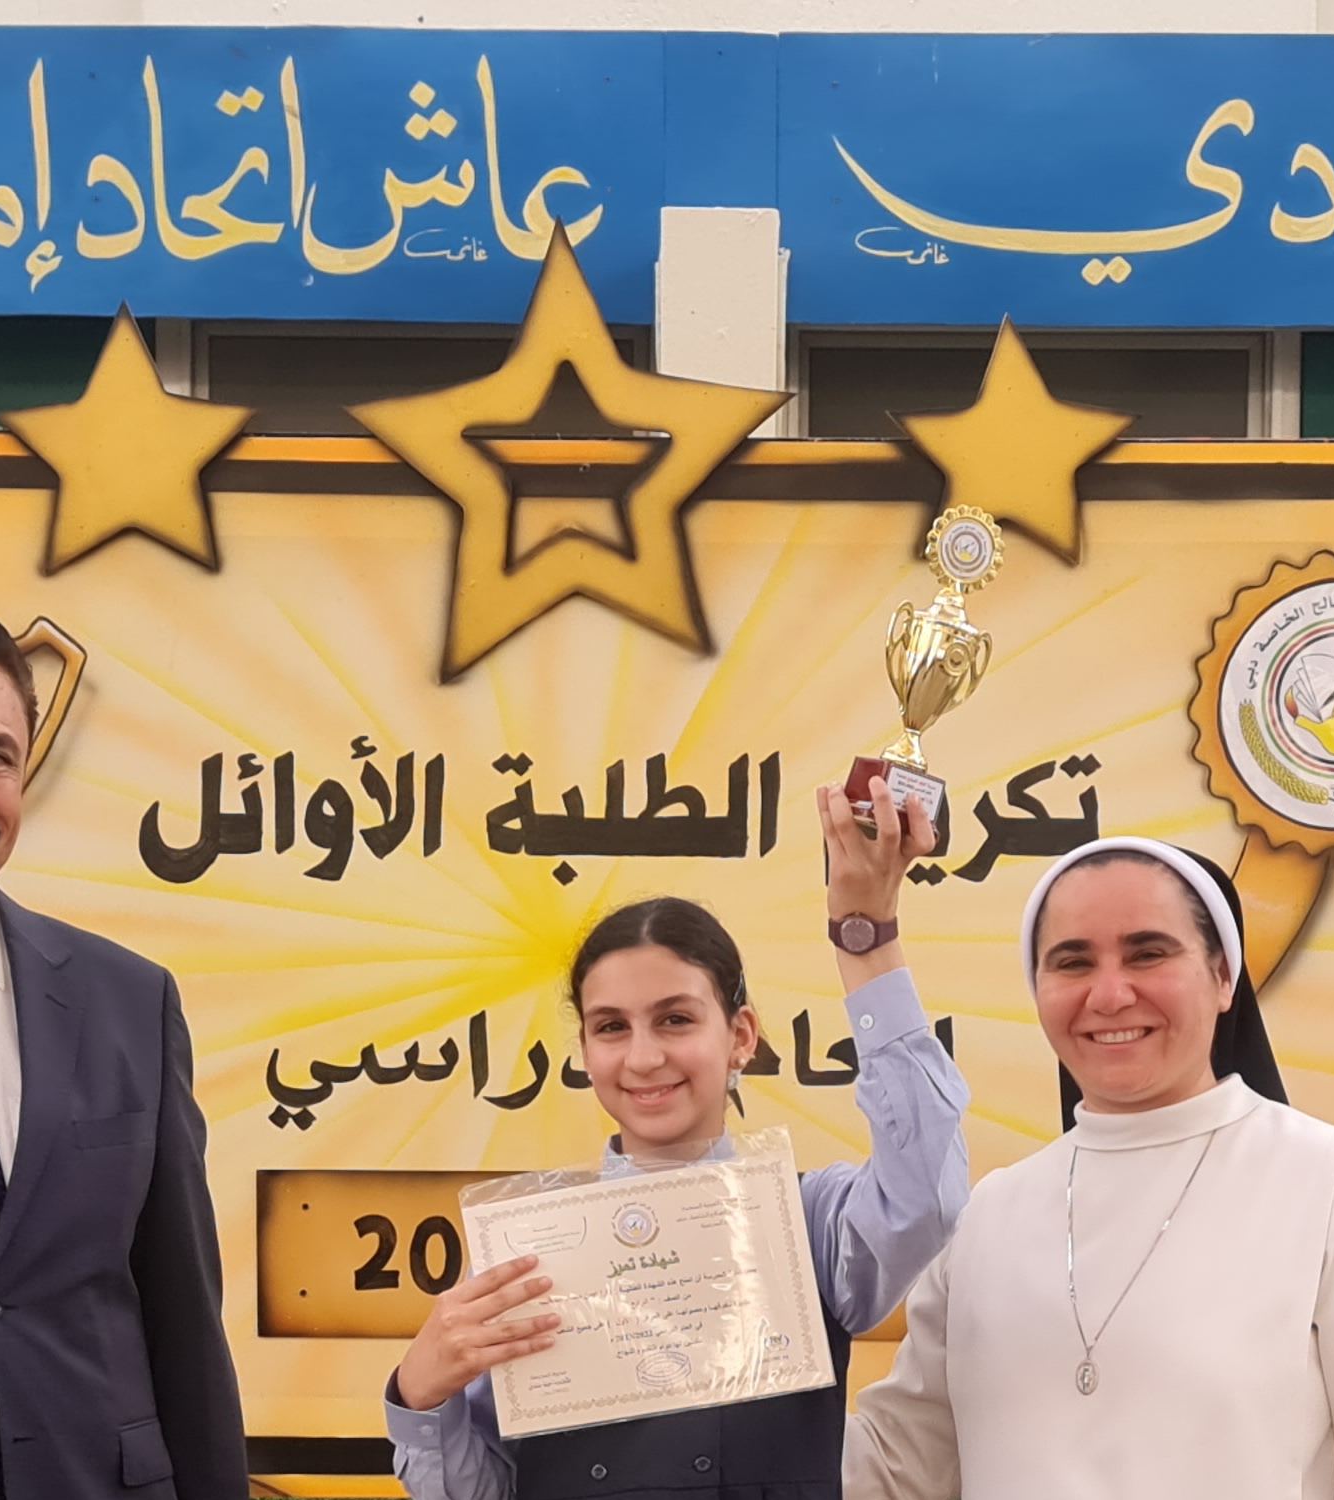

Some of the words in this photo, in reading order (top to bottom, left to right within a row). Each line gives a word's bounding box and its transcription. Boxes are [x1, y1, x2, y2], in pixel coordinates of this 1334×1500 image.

[303, 54, 604, 275] عاش
[1253, 606, 1305, 652] الخاصة
[138, 735, 445, 884] الأوائل
[486, 751, 780, 886] الطلبة
